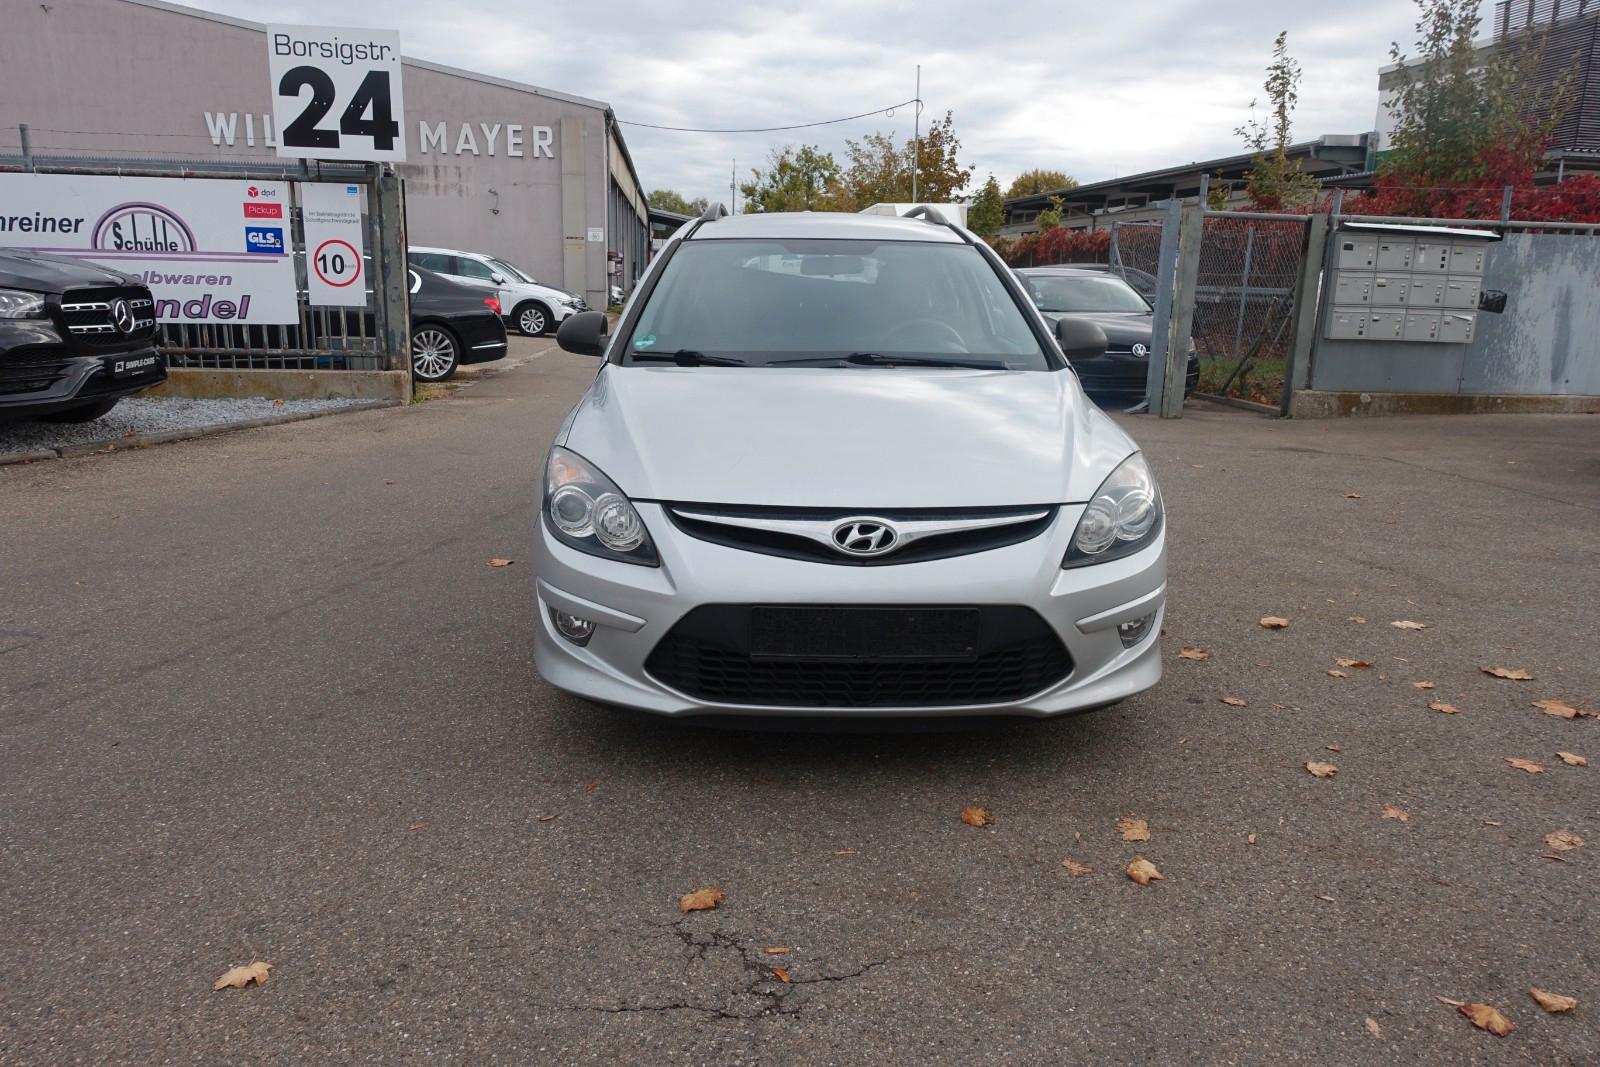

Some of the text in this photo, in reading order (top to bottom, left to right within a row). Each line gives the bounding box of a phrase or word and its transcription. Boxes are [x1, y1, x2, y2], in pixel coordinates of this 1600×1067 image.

[274, 33, 396, 65] Borsigstr.
[278, 65, 400, 151] 24
[419, 120, 555, 159] MAYER
[260, 188, 276, 197] dpd
[248, 205, 278, 215] Pickup
[112, 207, 179, 252] Schühle
[248, 231, 275, 244] GLS
[318, 253, 345, 275] 10
